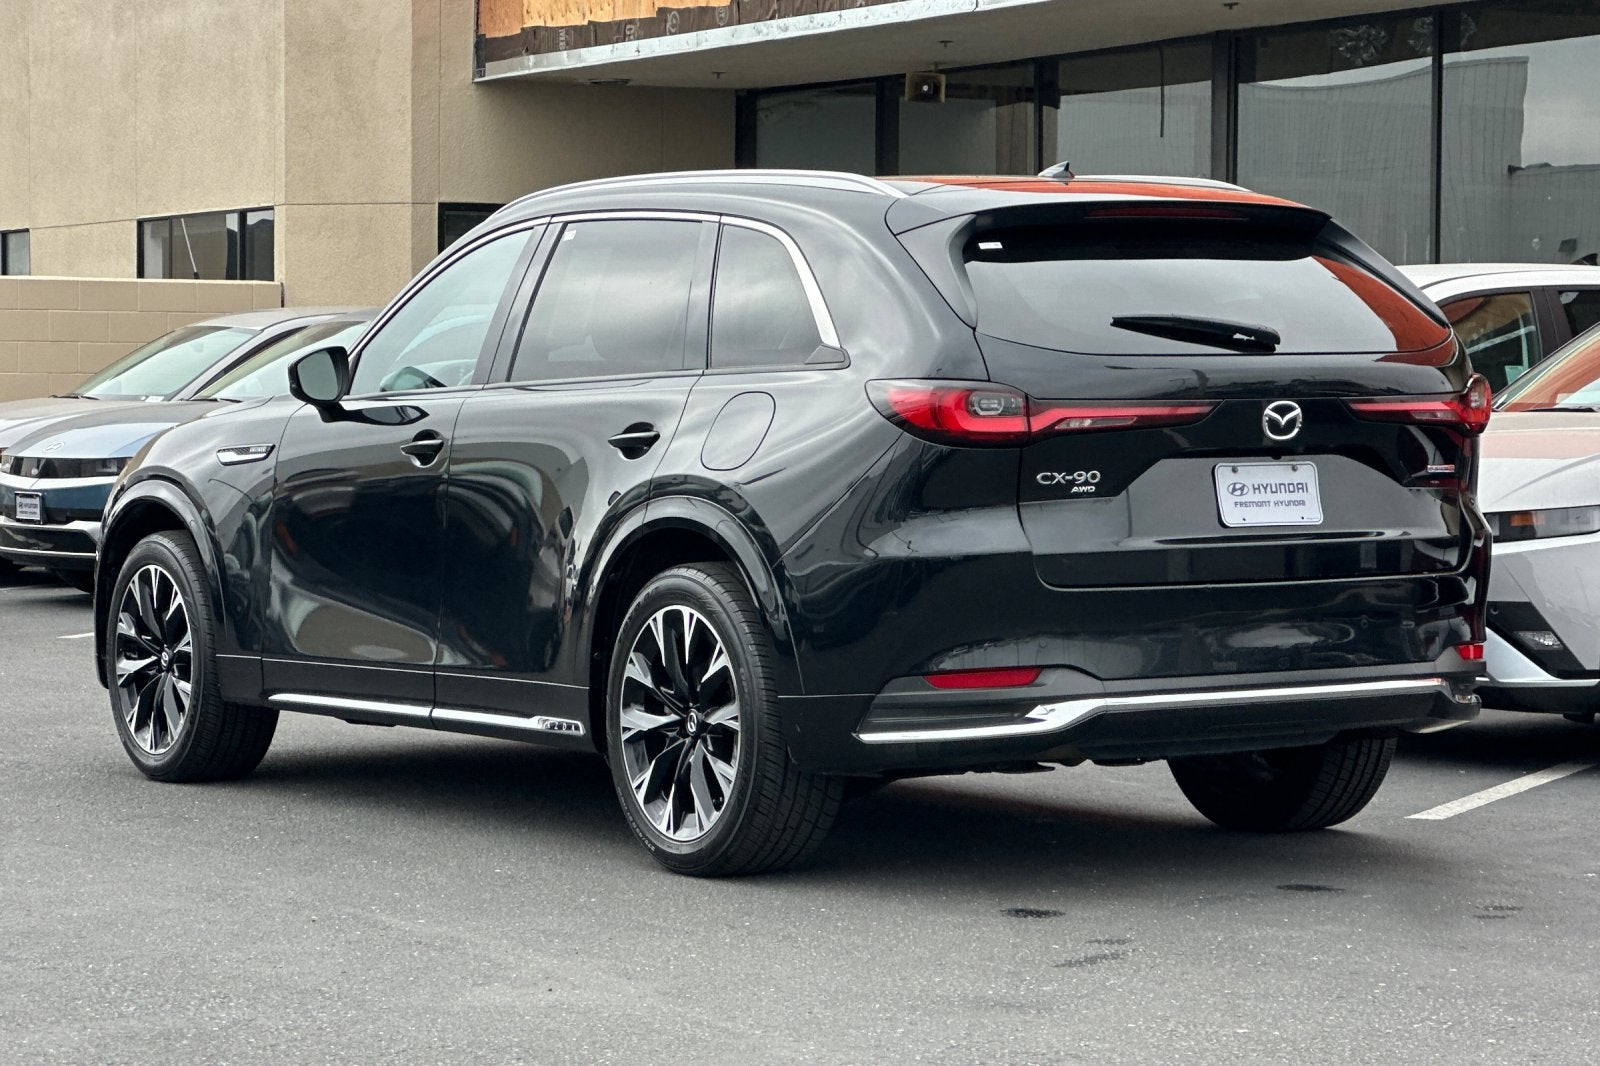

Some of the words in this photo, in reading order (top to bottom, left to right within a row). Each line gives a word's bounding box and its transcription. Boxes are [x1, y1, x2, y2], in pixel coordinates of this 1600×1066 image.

[1036, 470, 1101, 485] CX-90
[1070, 485, 1096, 493] AWD
[1252, 482, 1309, 495] HYUNDAI
[1234, 500, 1271, 508] FREMONT
[1273, 500, 1306, 508] HYUNDAI
